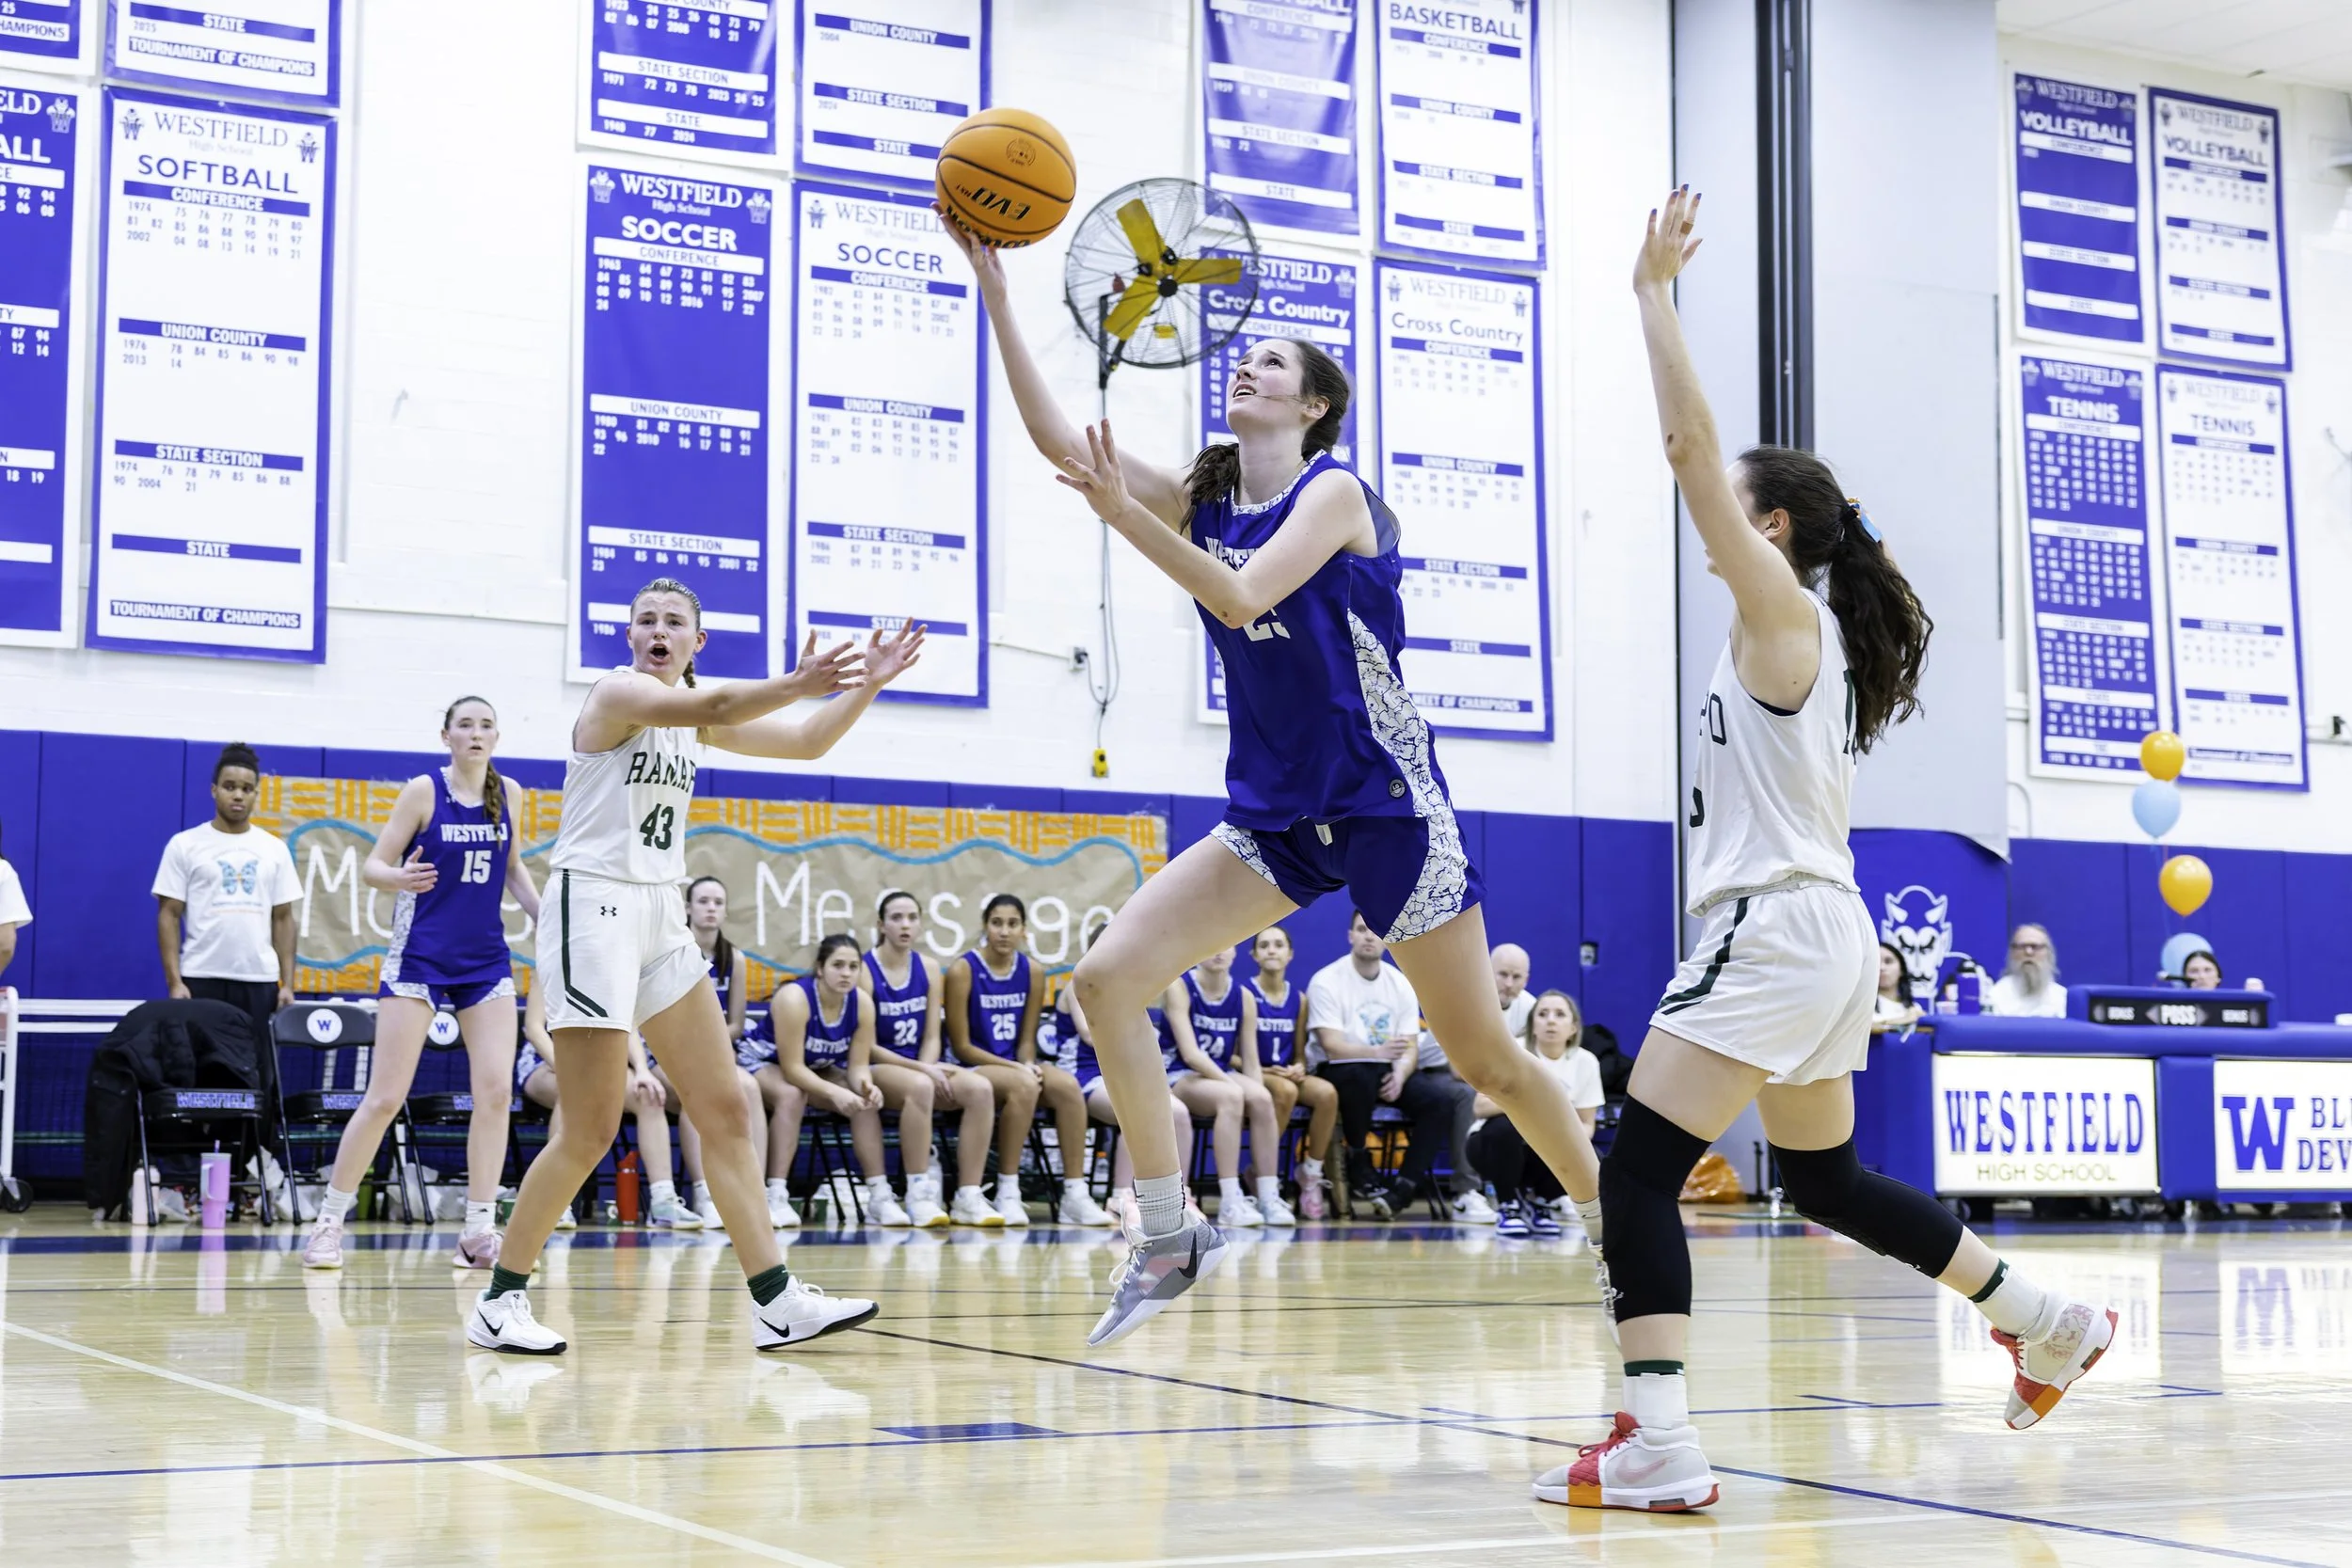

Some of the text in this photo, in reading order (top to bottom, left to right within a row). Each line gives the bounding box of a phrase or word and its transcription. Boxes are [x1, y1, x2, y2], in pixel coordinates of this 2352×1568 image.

[203, 14, 246, 33] STATE
[850, 19, 938, 44] UNION COUNTY
[1391, 3, 1522, 40] BASKETBALL
[130, 37, 313, 76] TOURNAMENT OF CHAMPIONS
[638, 60, 729, 85] STATE SECTION
[847, 87, 937, 113] STATE SECTION
[154, 111, 288, 148] WESTFIELD
[666, 112, 702, 128] STATE
[2020, 109, 2132, 147] VOLLEYBALL
[874, 139, 911, 156] STATE
[2163, 134, 2268, 167] VOLLEYBALL
[137, 154, 299, 194] SOFTBALL
[171, 186, 264, 212] CONFERENCE
[620, 173, 742, 209] WESTFIELD
[1265, 184, 1296, 200] STATE
[128, 200, 302, 231] 1974 75 76 77 78 79 80
[652, 199, 711, 216] High School
[127, 215, 186, 231] 81 85
[621, 215, 738, 251] SOCCER
[127, 230, 301, 260] 2002 04 08 13 14 19 21
[640, 246, 720, 267] CONFERENCE
[837, 243, 944, 274] SOCCER
[1410, 276, 1506, 304] WESTFIELD
[1268, 296, 1350, 328] Country
[161, 322, 267, 347] UNION COUNTY
[1391, 312, 1523, 347] Cross Country
[11, 342, 50, 357] 12 14
[123, 339, 230, 360] 1976 78 85
[123, 354, 183, 369] 2013 14
[630, 402, 723, 421] UNION COUNTY
[843, 396, 933, 420] UNION COUNTY
[2045, 395, 2120, 423] TENNIS
[2190, 414, 2256, 436] TENNIS
[155, 444, 263, 468] STATE SECTION
[7, 469, 45, 484] 18 19
[114, 476, 197, 492] 90 2004 21
[115, 461, 245, 483] 1974 76 78 79 85
[629, 533, 723, 551] STATE SECTION
[843, 525, 933, 546] STATE SECTION
[186, 541, 230, 559] STATE
[111, 601, 300, 628] TOURNAMENT OF CHAMPIONS
[1450, 640, 1481, 655] STATE
[640, 803, 674, 850] 43
[460, 849, 491, 884] 15
[980, 992, 1026, 1009] WESTFIELD
[318, 1020, 331, 1032] W
[991, 1013, 1016, 1041] 25
[2161, 1005, 2196, 1025] POSS
[436, 1022, 450, 1034] W
[893, 1018, 918, 1047] 22
[1199, 1034, 1225, 1058] 24
[1272, 1037, 1280, 1061] 1
[177, 1092, 255, 1110] WESTFIELD
[1945, 1090, 2143, 1154] WESTFIELD
[2221, 1094, 2296, 1172] W
[1978, 1163, 2117, 1181] HIGH SCHOOL
